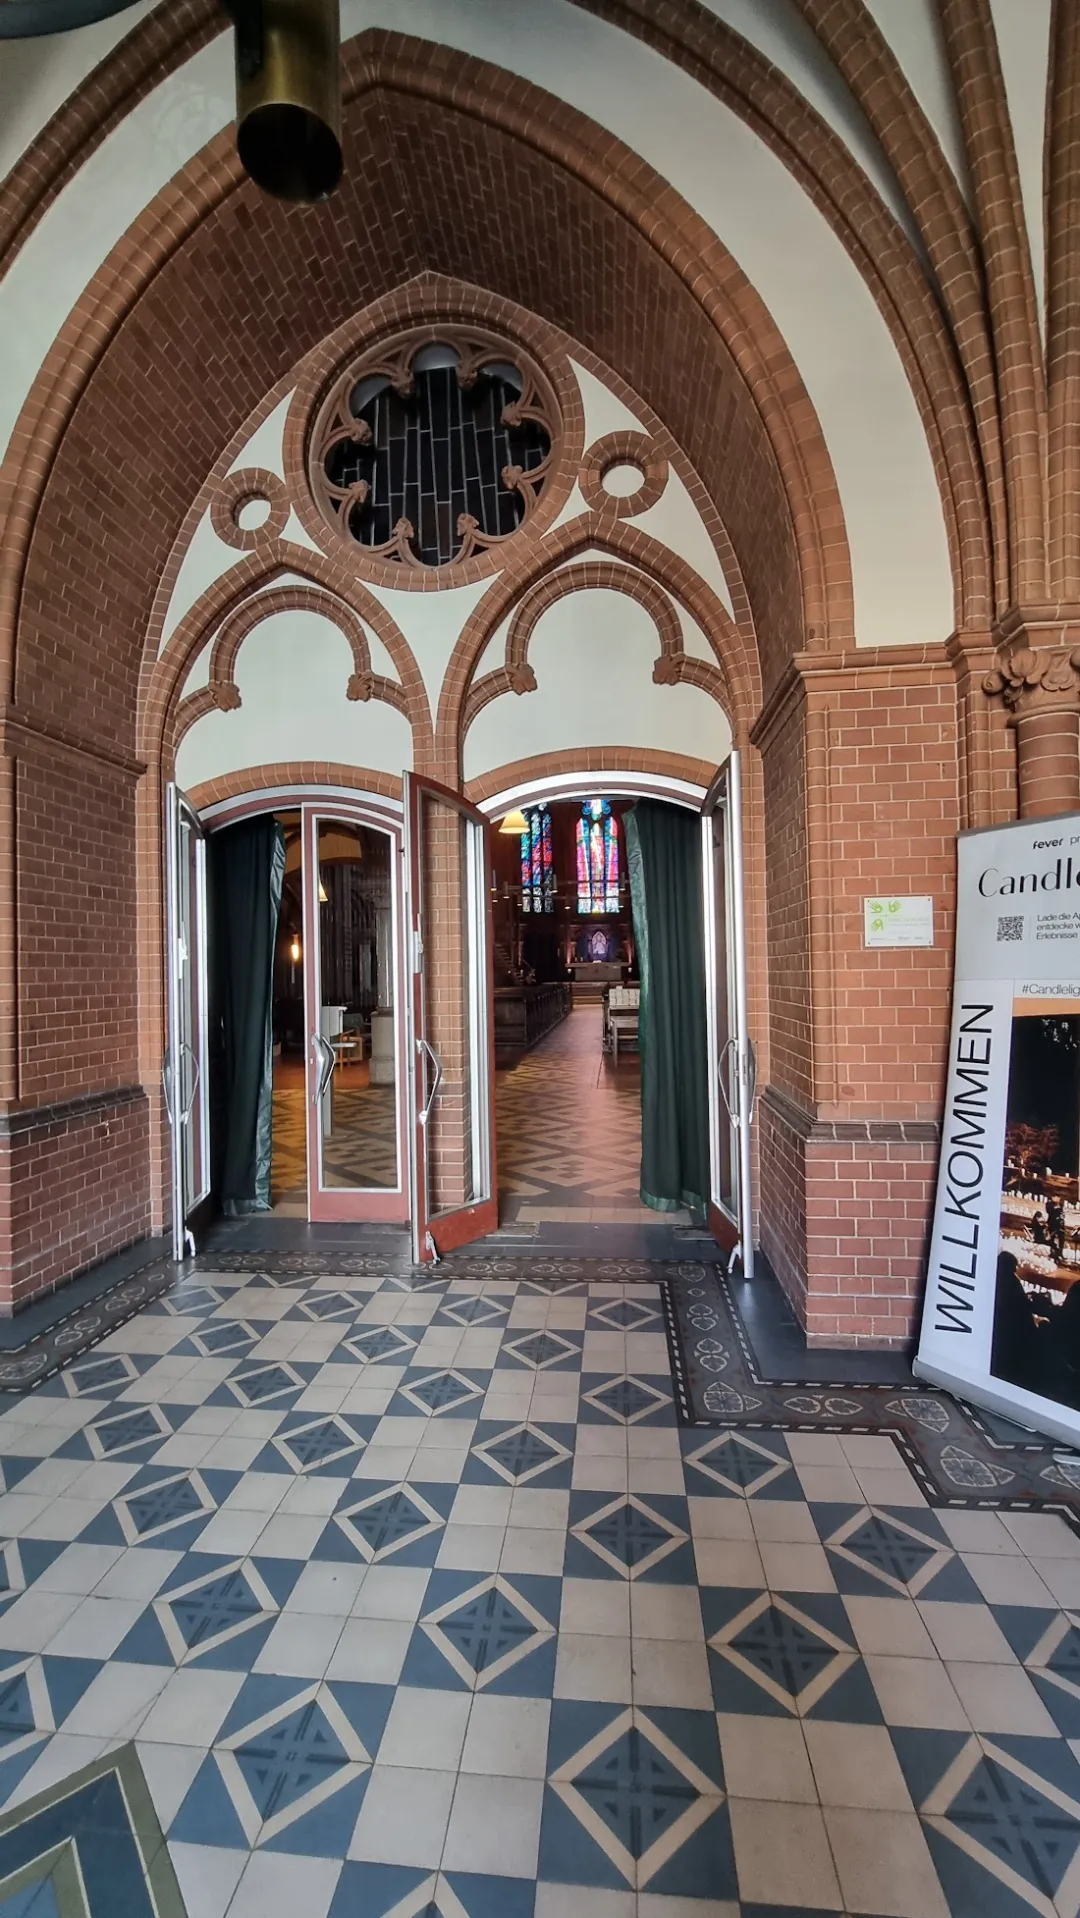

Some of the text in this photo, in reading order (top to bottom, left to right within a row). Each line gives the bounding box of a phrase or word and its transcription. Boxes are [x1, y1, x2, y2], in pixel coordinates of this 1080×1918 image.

[1032, 837, 1064, 849] fever
[978, 857, 1080, 897] Candl
[1037, 914, 1057, 922] Lade
[1058, 912, 1071, 920] die
[1036, 922, 1073, 931] entdecke
[1036, 932, 1078, 940] Erlebnisse
[934, 1003, 995, 1335] WILLKOMMEN
